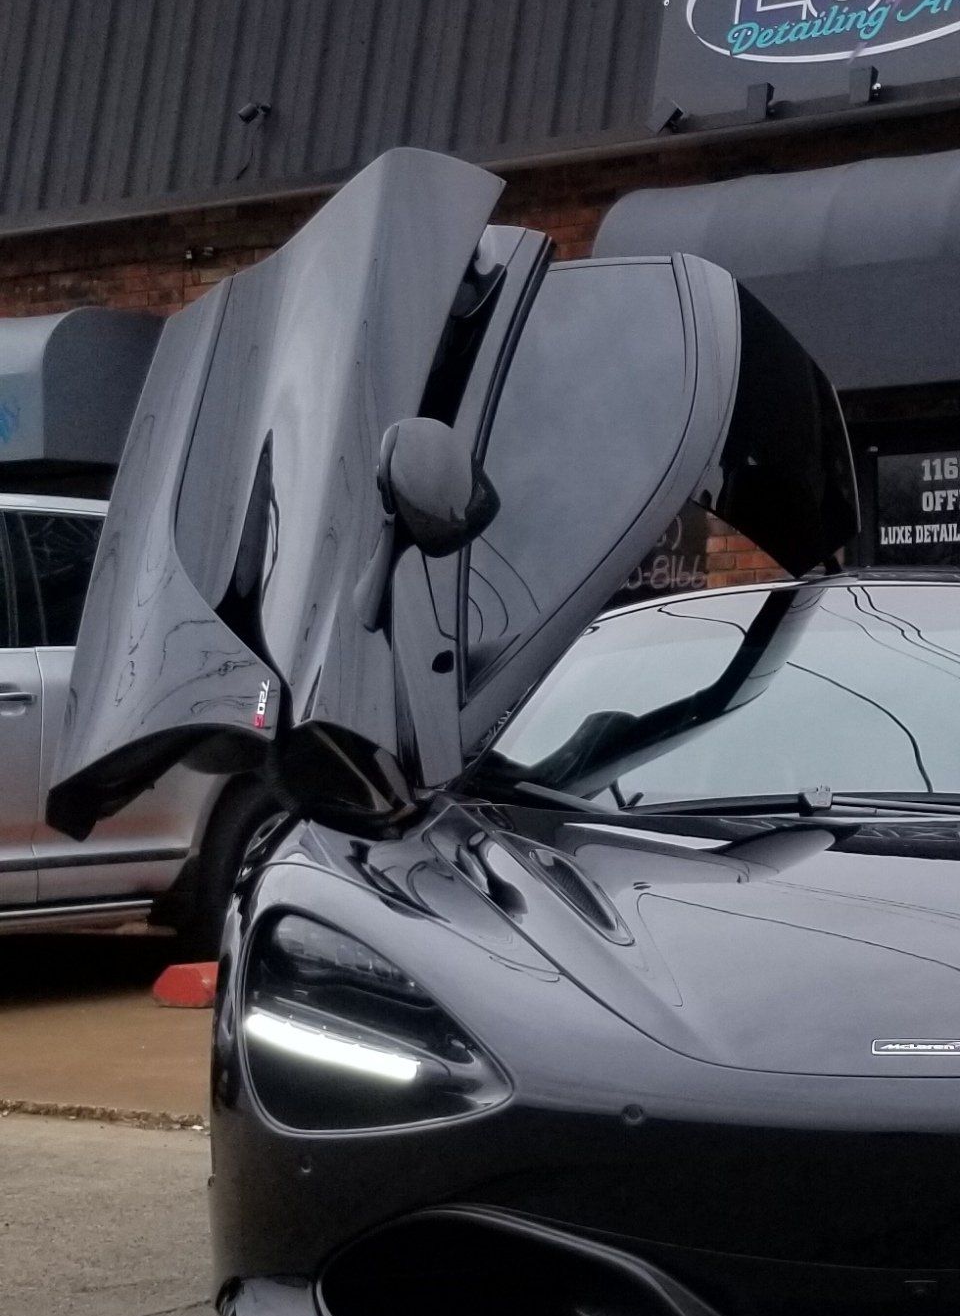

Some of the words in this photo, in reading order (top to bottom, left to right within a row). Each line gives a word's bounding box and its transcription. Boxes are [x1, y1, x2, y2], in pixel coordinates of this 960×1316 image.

[727, 3, 891, 56] Detailing
[880, 526, 913, 545] LUXE
[254, 679, 270, 729] 720S
[880, 1042, 960, 1050] McLaren
